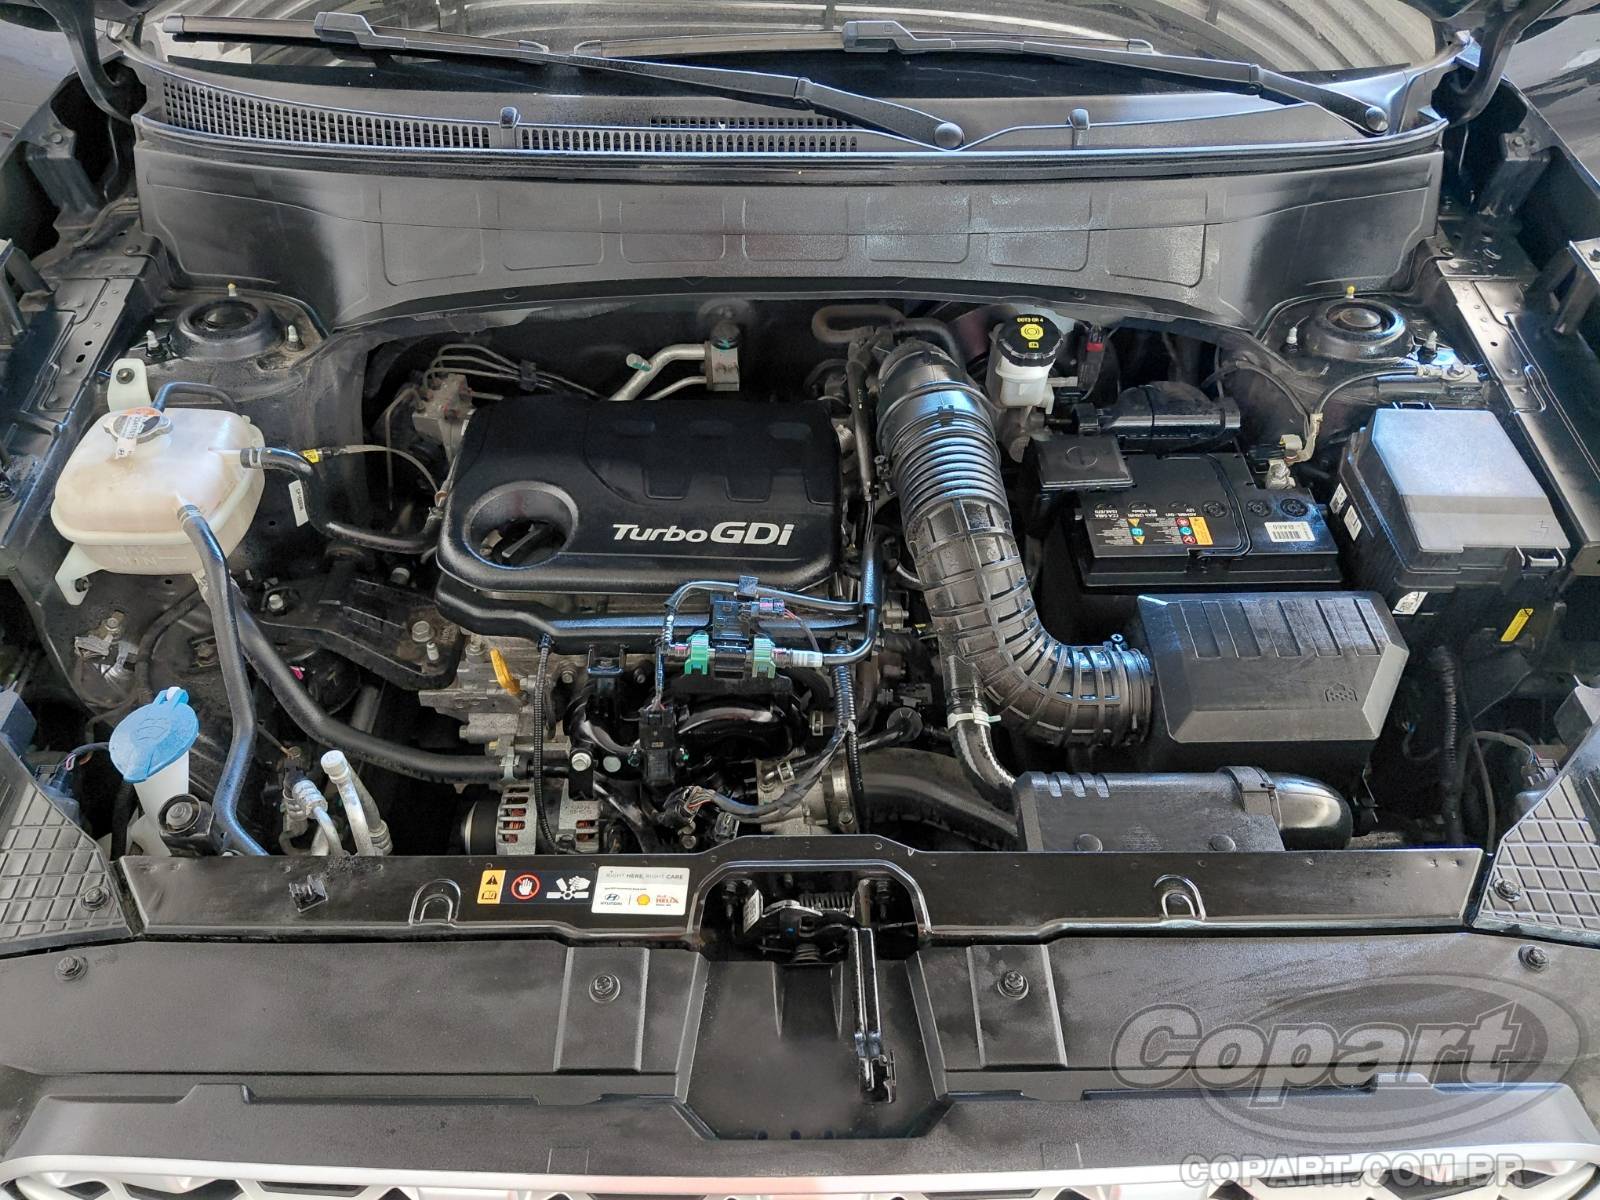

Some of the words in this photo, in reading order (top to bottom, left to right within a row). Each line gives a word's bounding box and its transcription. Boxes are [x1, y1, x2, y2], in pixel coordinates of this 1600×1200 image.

[612, 524, 708, 543] Turbo
[710, 521, 795, 546] GDi
[655, 896, 680, 904] HELIX
